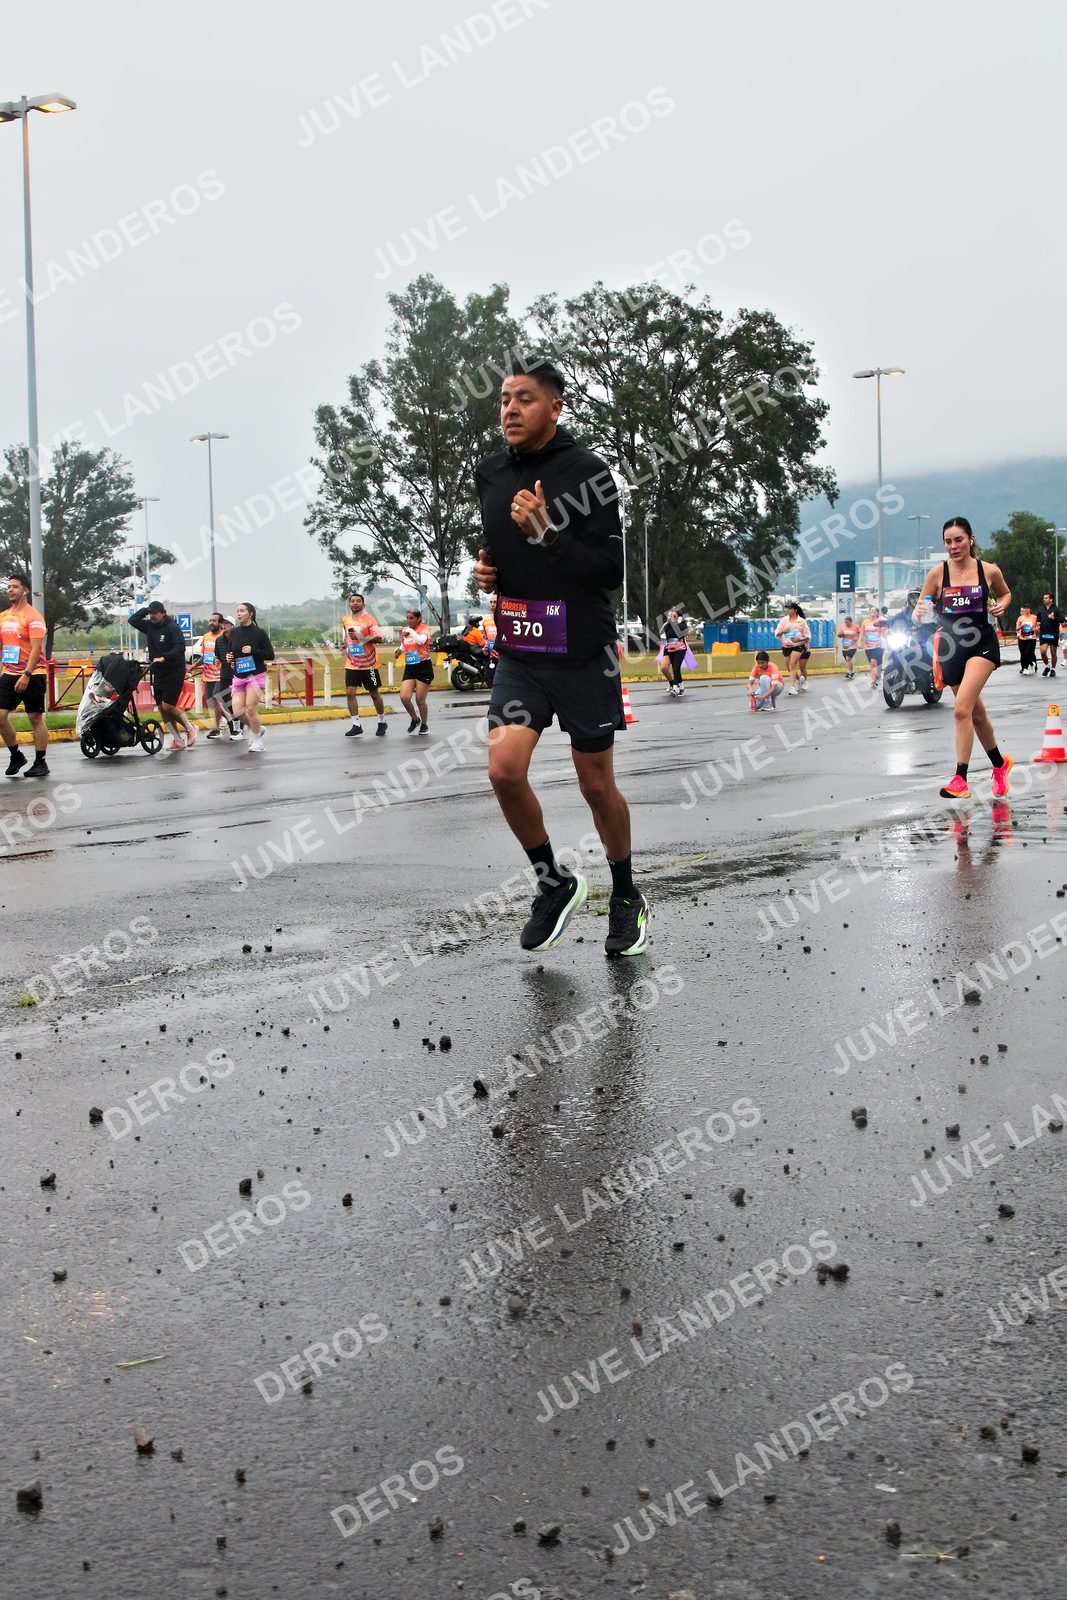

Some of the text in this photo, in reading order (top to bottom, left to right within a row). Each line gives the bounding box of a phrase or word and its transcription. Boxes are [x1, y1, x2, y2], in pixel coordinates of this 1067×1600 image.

[840, 574, 850, 588] E
[952, 597, 971, 606] 284
[512, 620, 543, 637] 370
